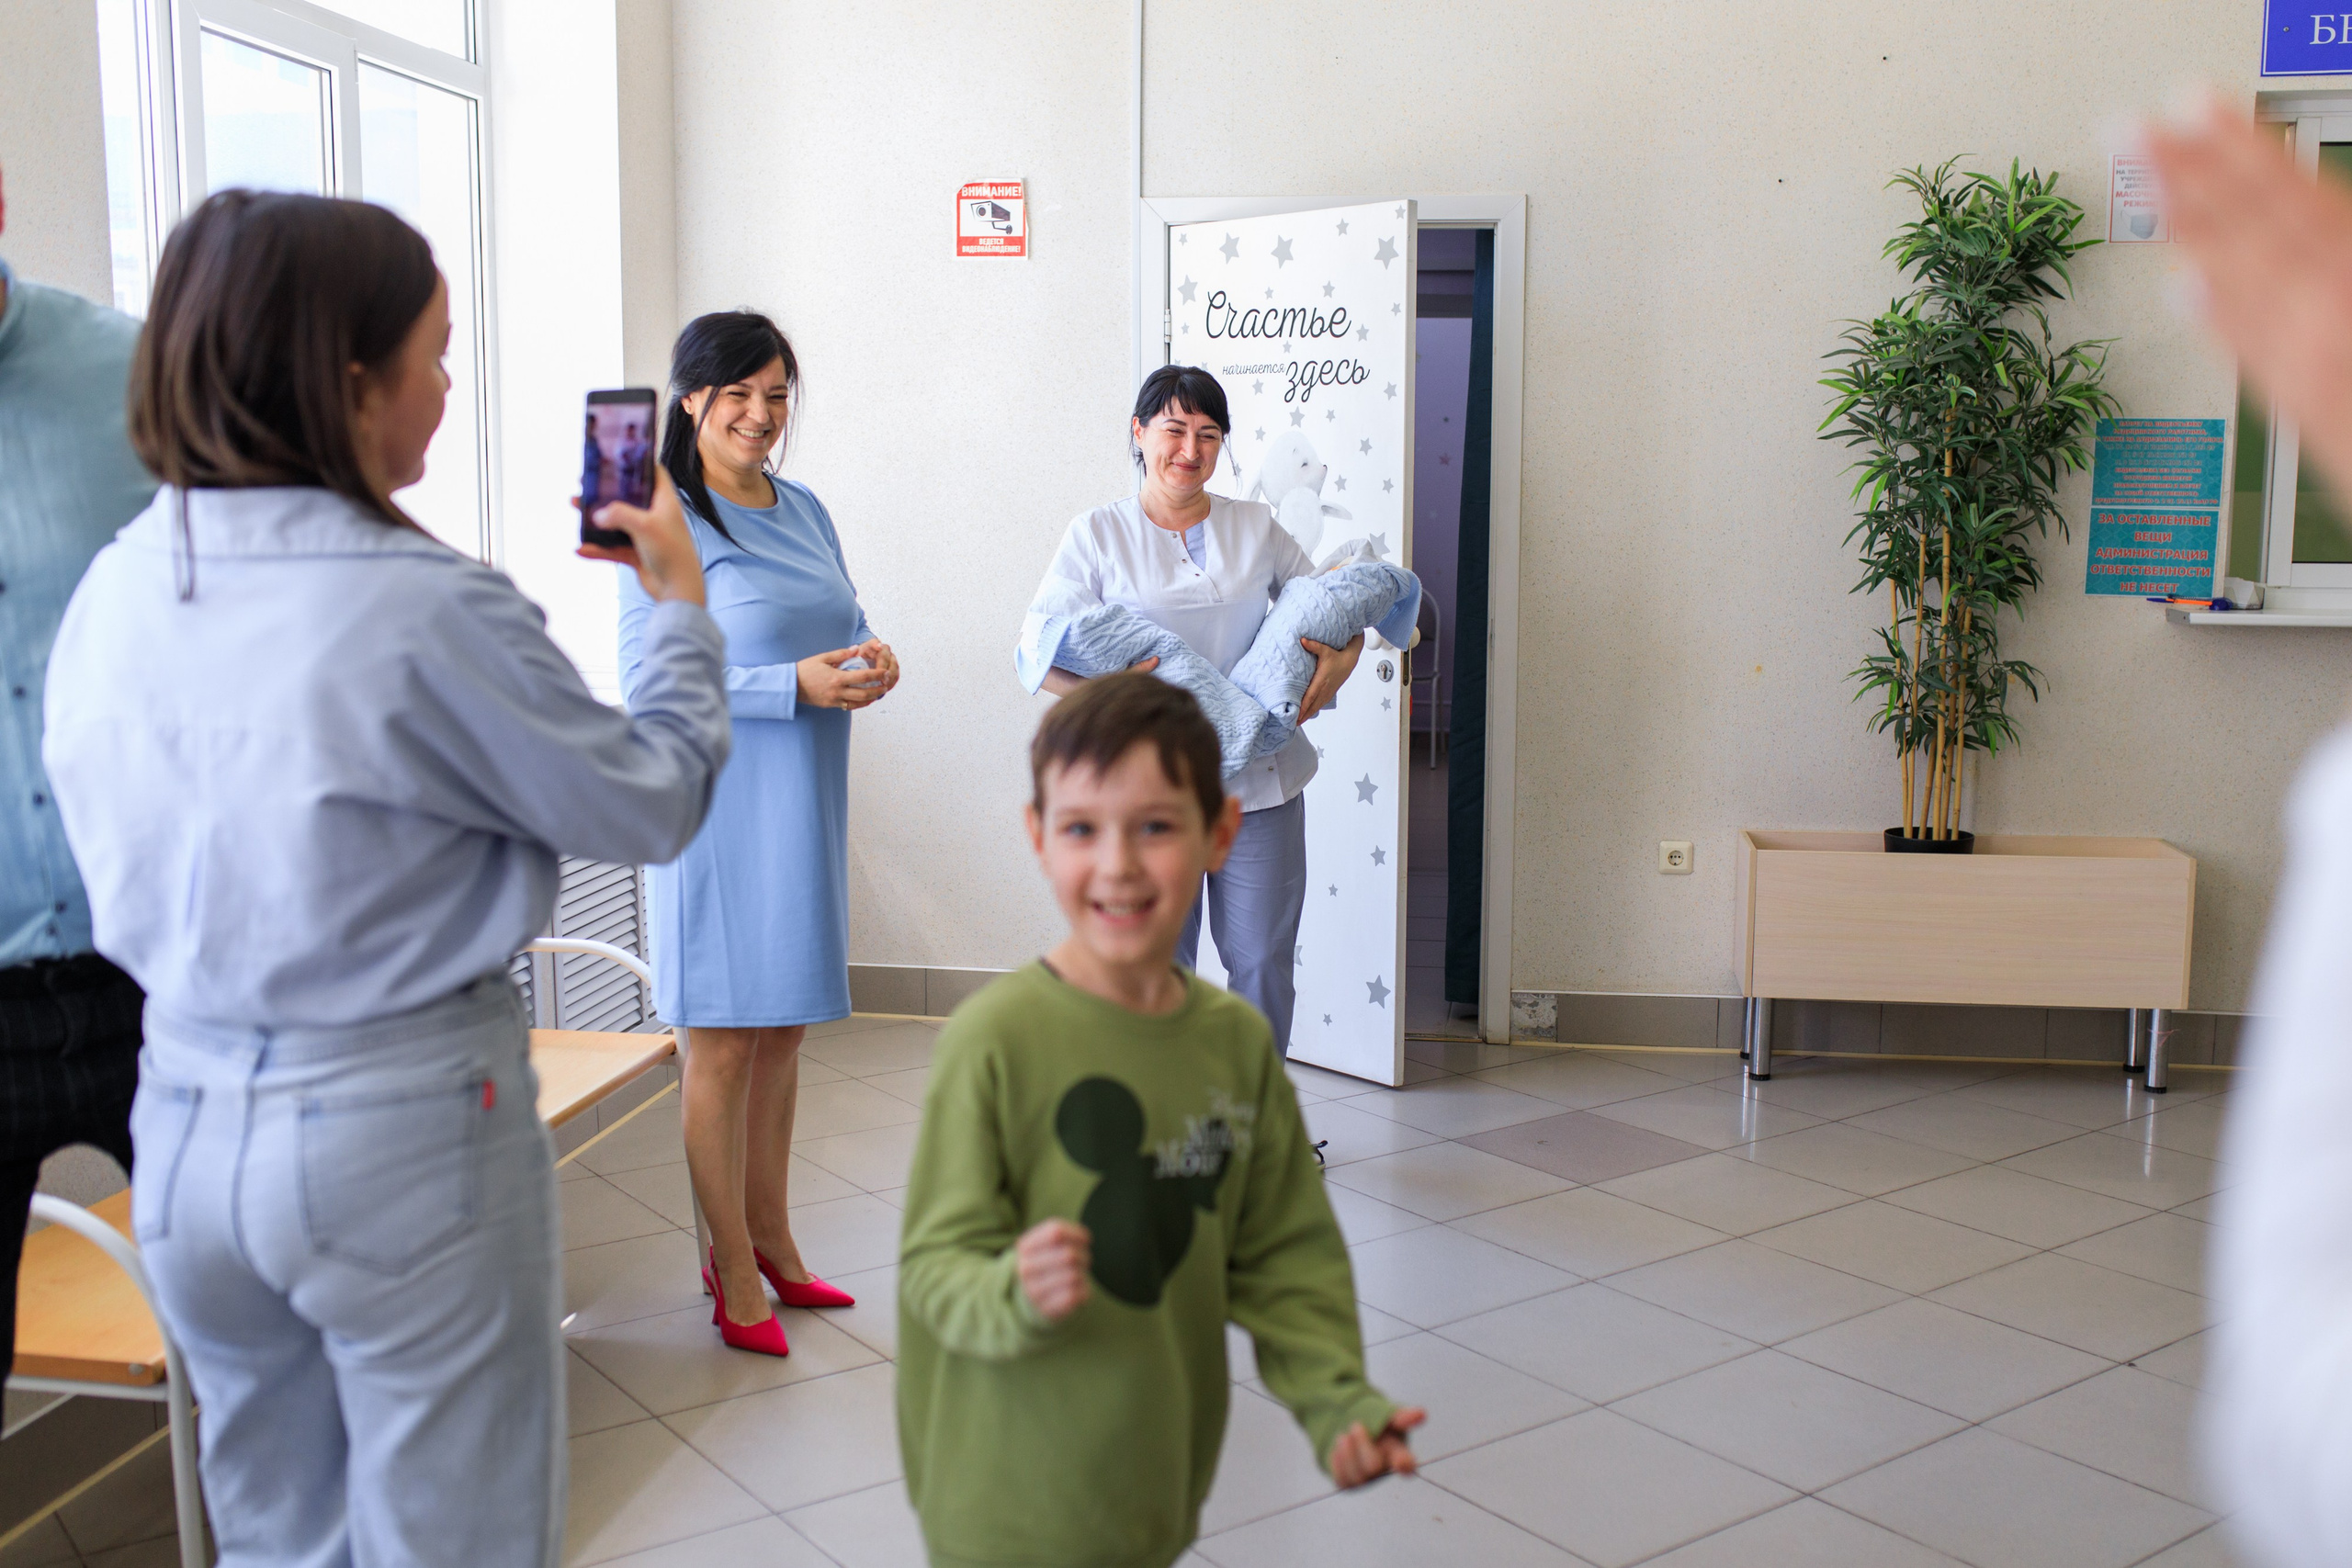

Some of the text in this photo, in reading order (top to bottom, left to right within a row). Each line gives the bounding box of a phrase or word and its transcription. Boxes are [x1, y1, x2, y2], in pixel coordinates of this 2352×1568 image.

[961, 186, 1022, 197] ВНИМАНИЕ!
[1205, 290, 1352, 339] Счастье
[1222, 358, 1371, 403] начинается здесь
[2098, 513, 2211, 526] ЗА ОСТАВЛЕННЫЕ
[2133, 532, 2173, 544] ВЕЩИ
[2095, 547, 2209, 561] АДМИНИСТРАЦИЯ
[2090, 564, 2211, 577] ОТВЕТСТВЕННОСТИ
[2120, 582, 2179, 593] НЕ НЕСЕТ
